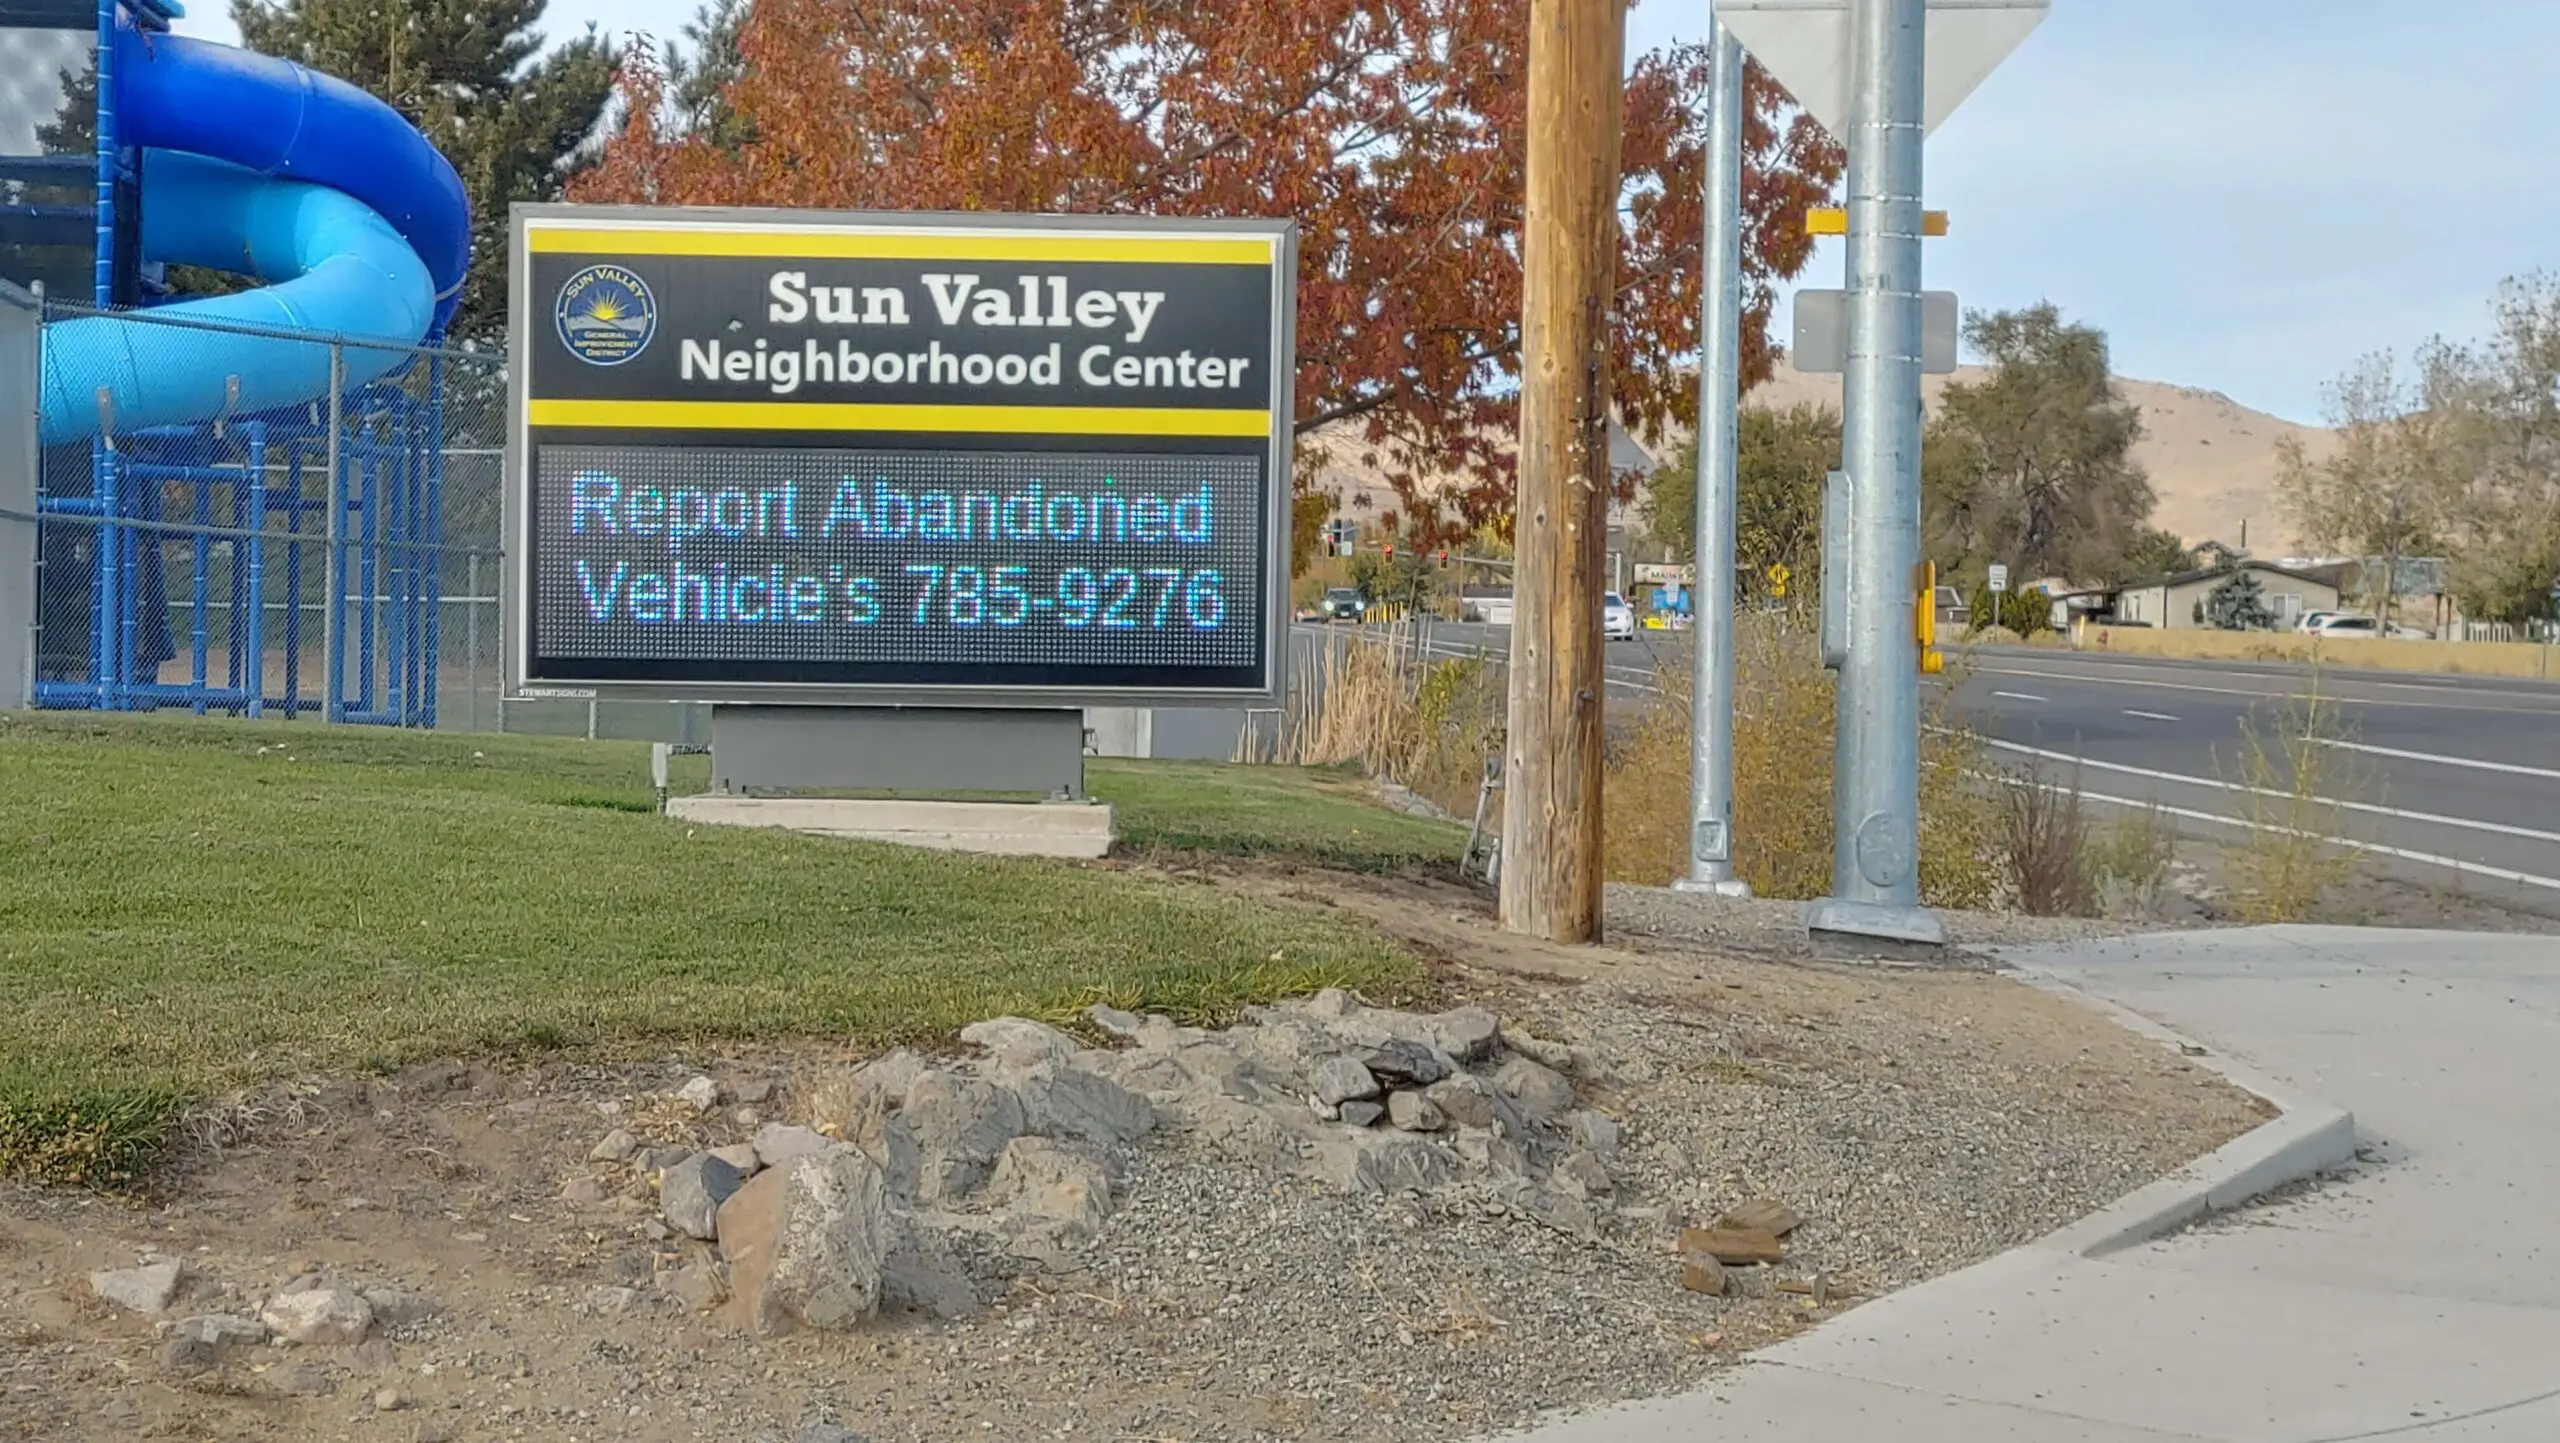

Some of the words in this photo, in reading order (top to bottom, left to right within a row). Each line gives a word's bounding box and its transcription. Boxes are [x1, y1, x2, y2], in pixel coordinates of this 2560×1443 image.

[567, 275, 594, 298] SUN
[595, 268, 645, 298] VALLEY
[768, 271, 911, 325] Sun
[920, 274, 1165, 342] Valley
[681, 339, 1061, 393] Neighborhood
[1078, 344, 1249, 388] Center
[571, 470, 798, 554] Report
[822, 475, 1214, 542] Abandoned
[576, 560, 880, 623] Vehicle's
[904, 565, 1226, 628] 785-9276
